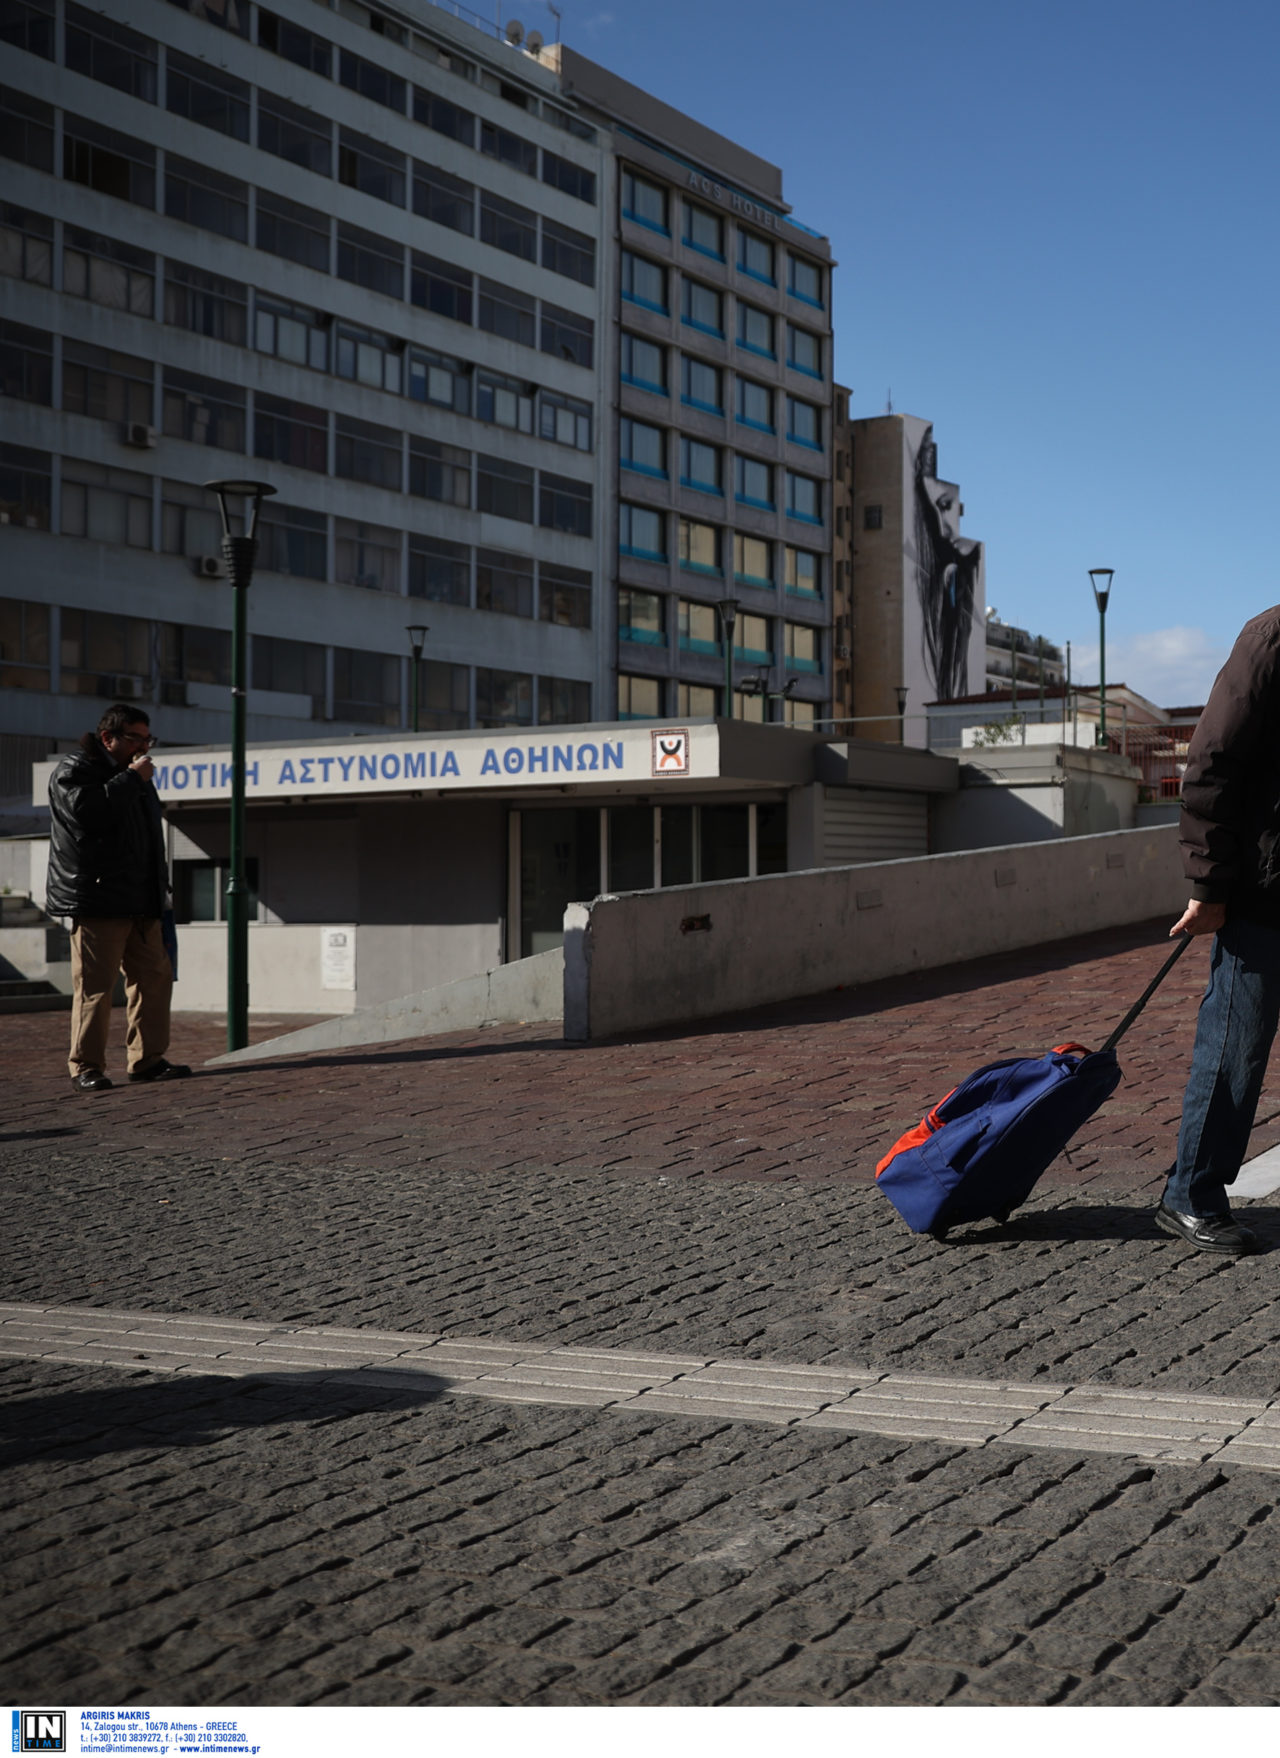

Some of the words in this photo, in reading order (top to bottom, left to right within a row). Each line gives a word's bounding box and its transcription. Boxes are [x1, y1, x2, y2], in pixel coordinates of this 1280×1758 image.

[732, 192, 780, 231] HOTEL
[153, 761, 259, 790] ΜΟΤΙΚΗ
[278, 750, 460, 785] ΑΣΤΥΝΟΜΙΑ
[480, 742, 624, 776] ΑΘΗΝΩΝ
